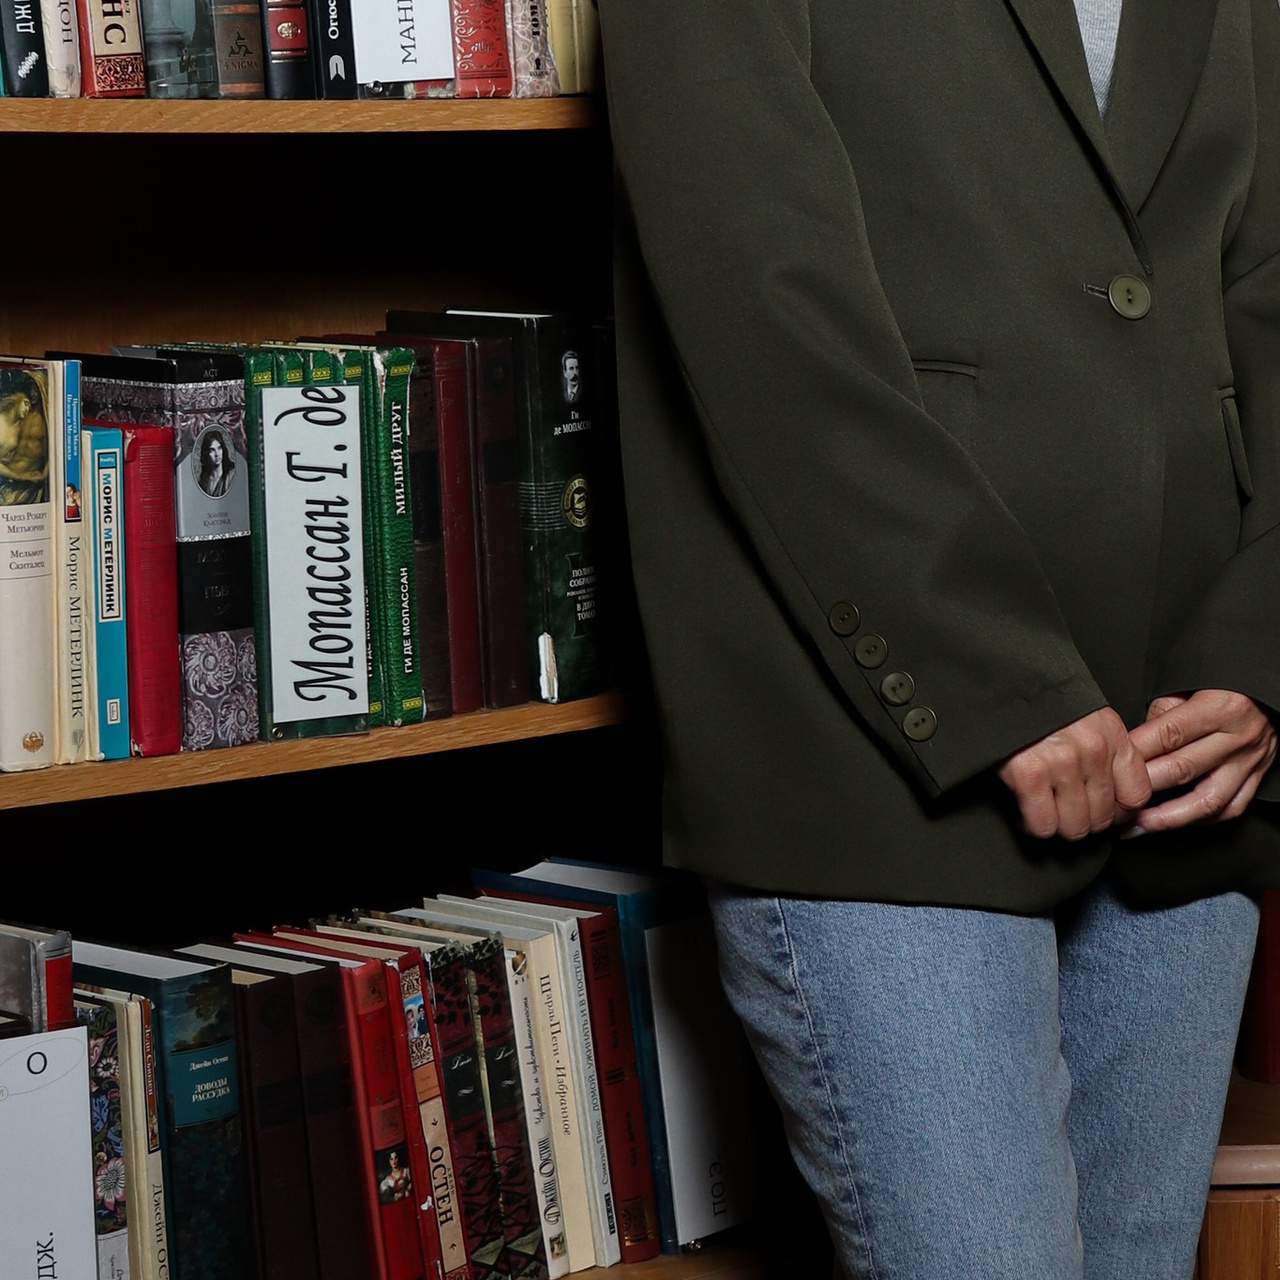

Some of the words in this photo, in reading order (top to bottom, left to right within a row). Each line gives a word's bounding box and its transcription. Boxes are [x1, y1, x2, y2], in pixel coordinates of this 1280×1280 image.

[203, 368, 218, 378] АСТ
[273, 386, 348, 427] де
[390, 401, 408, 457] ДРУГ
[102, 472, 113, 525] МОРИС
[392, 456, 407, 516] МИЛЫЙ
[9, 559, 46, 571] Скиталец
[67, 535, 81, 592] Морис
[103, 527, 116, 615] МЕТЕРЛИНК
[290, 495, 358, 702] Мопассан
[400, 566, 410, 629] МОПАССАН
[68, 596, 84, 719] МЕТЕРЛИНК
[403, 631, 413, 655] ДЕ
[404, 655, 414, 674] ГИ
[539, 973, 555, 1022] Шарль
[26, 1051, 48, 1075] О
[549, 1021, 563, 1057] Пеги
[191, 1088, 231, 1103] РАССУДКА
[193, 1077, 229, 1094] ДОВОДЫ
[555, 1064, 573, 1137] Избранное
[430, 1145, 455, 1227] ОСТЕН
[710, 1182, 728, 1218] ПО
[151, 1183, 166, 1245] Джейн
[36, 1231, 58, 1280] ДЖ.
